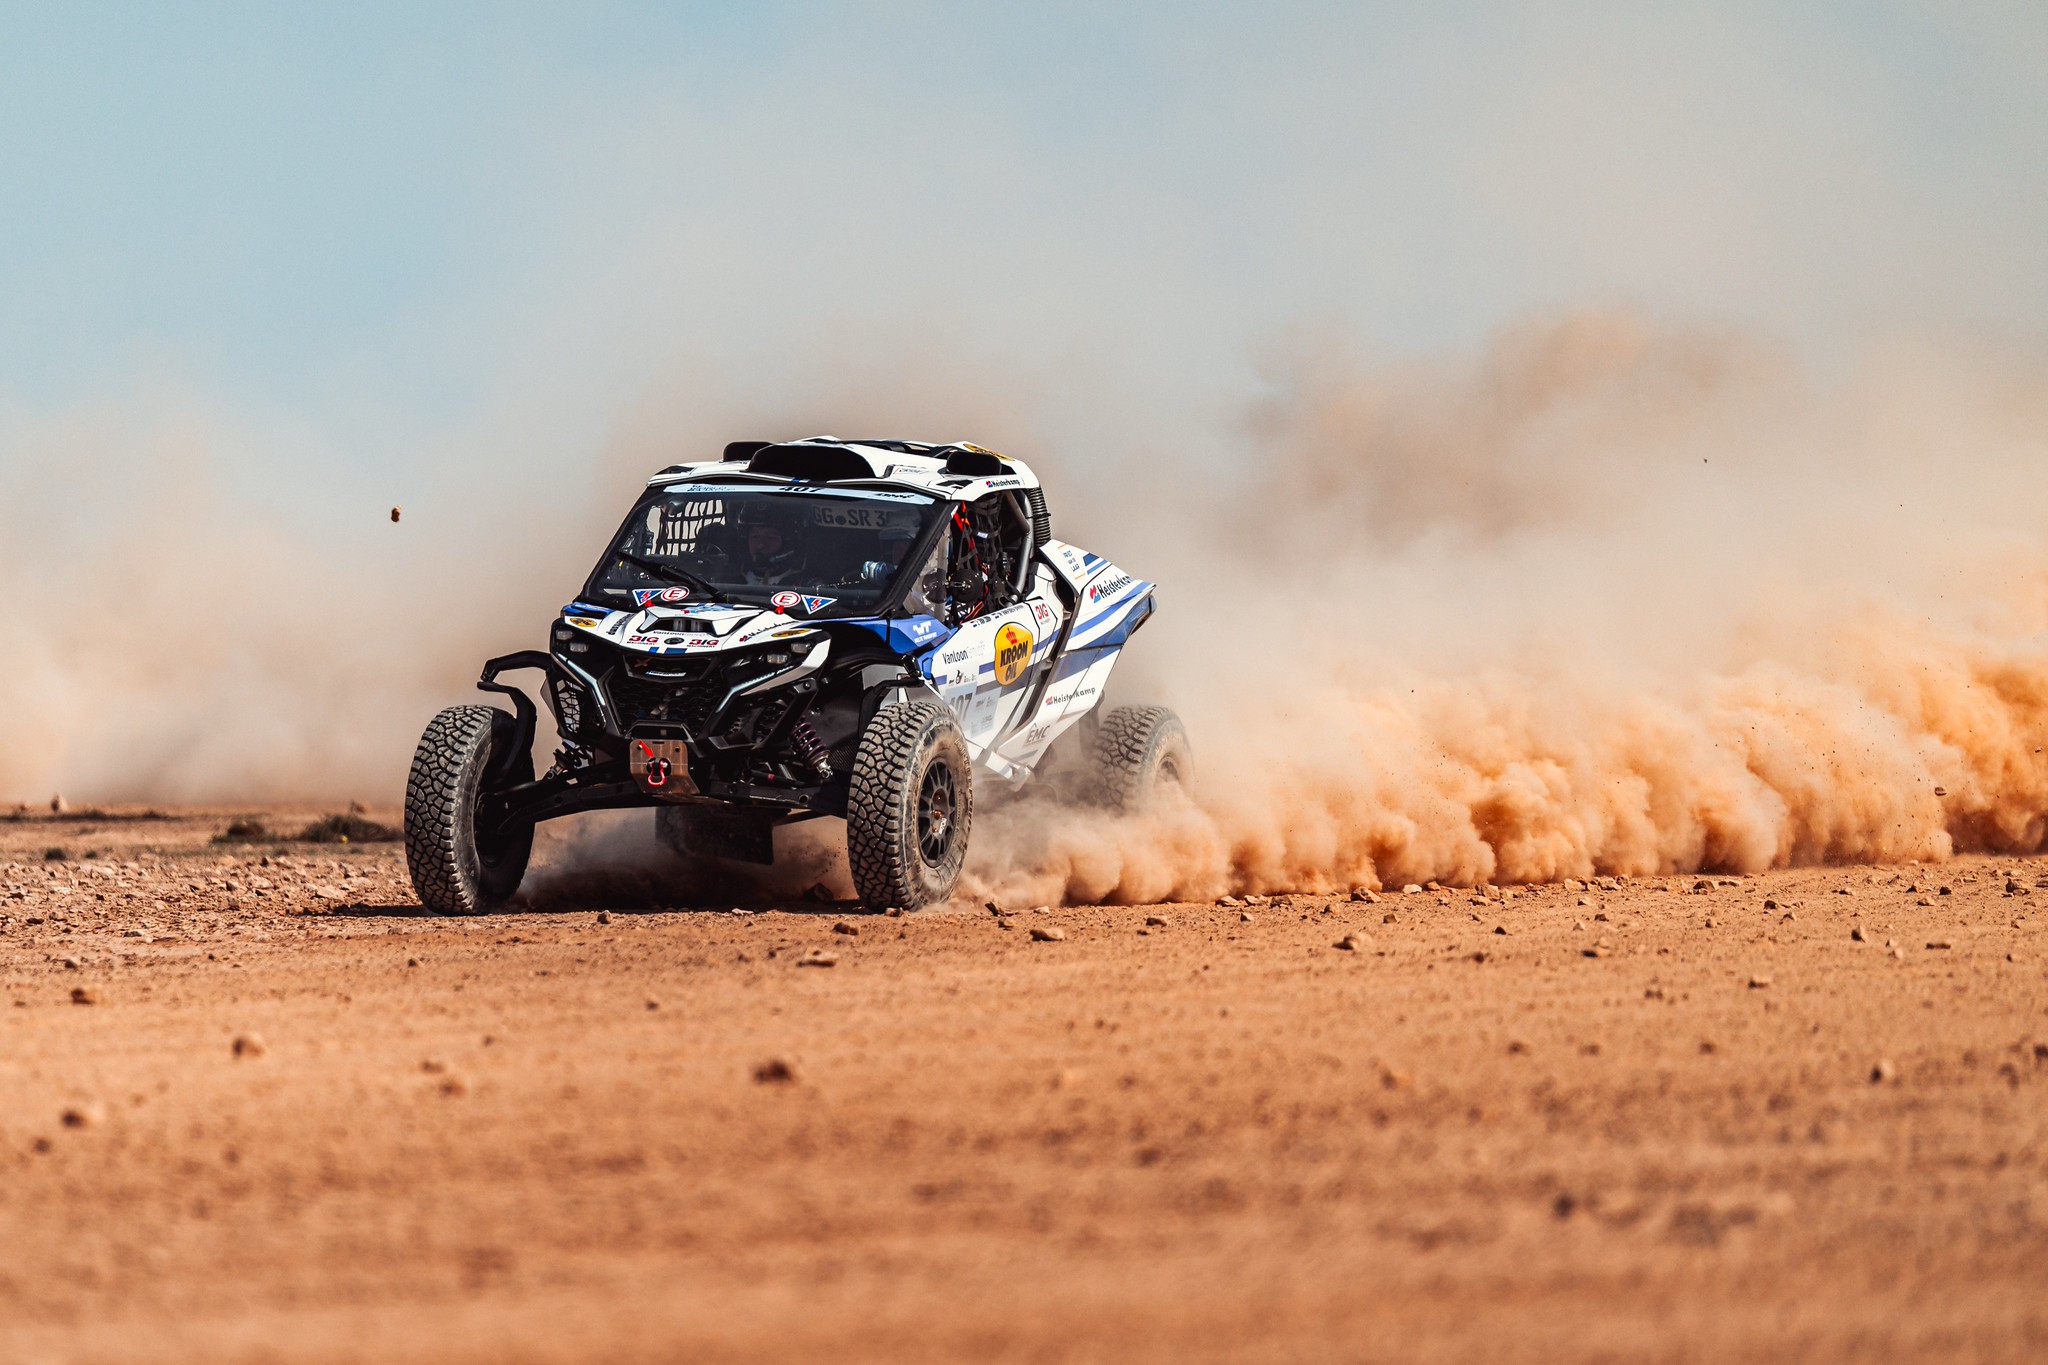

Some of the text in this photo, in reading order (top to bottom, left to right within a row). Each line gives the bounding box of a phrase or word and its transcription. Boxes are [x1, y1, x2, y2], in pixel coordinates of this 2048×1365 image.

[848, 510, 871, 526] SR
[1000, 640, 1029, 668] KROON
[1004, 663, 1018, 682] OIL
